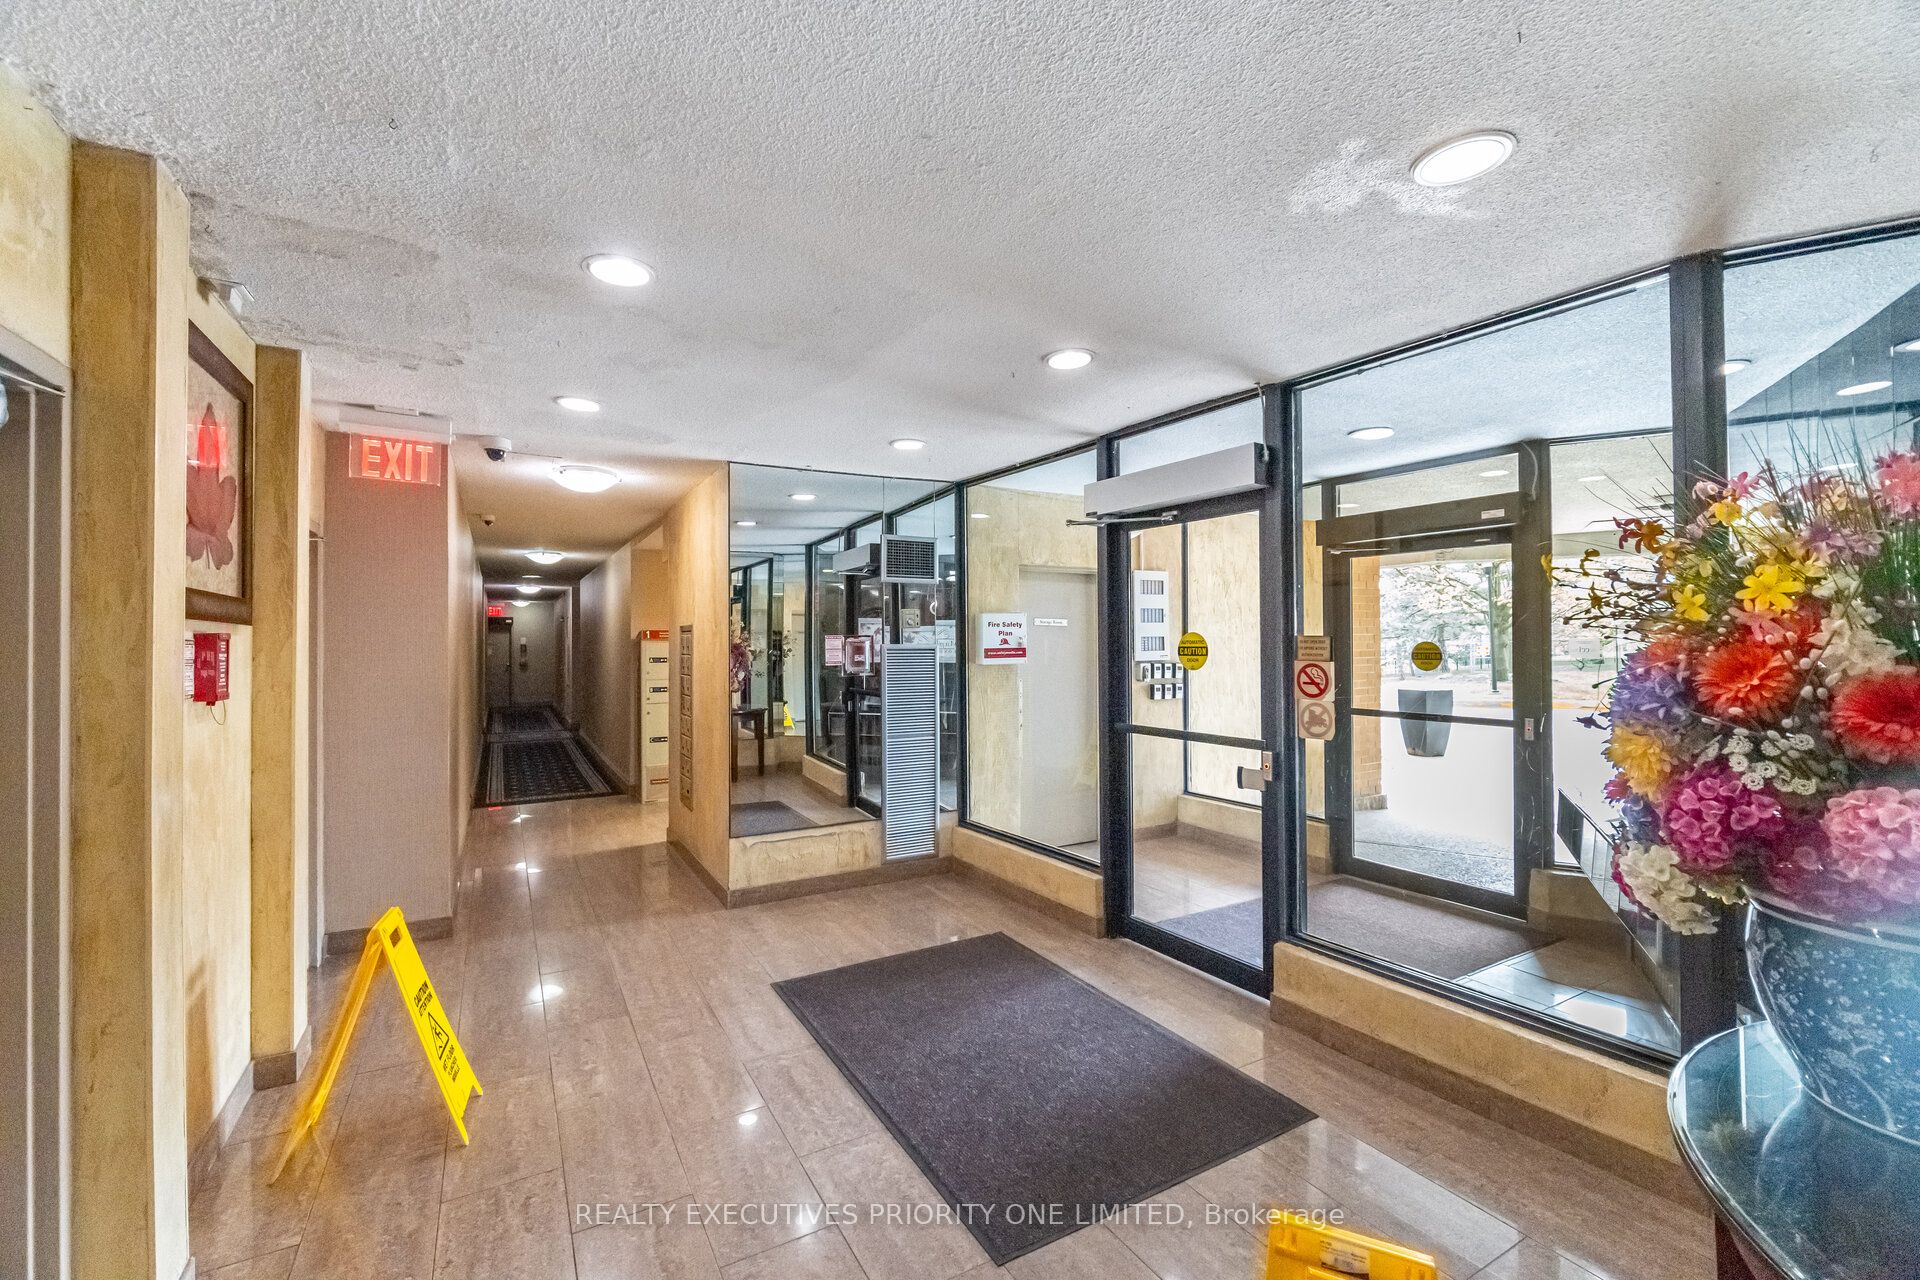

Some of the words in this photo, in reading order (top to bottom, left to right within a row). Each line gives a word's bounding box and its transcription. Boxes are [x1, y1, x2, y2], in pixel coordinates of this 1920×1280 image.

[361, 438, 433, 482] EXIT
[1002, 621, 1022, 629] Safety
[1179, 647, 1207, 655] CAUTION
